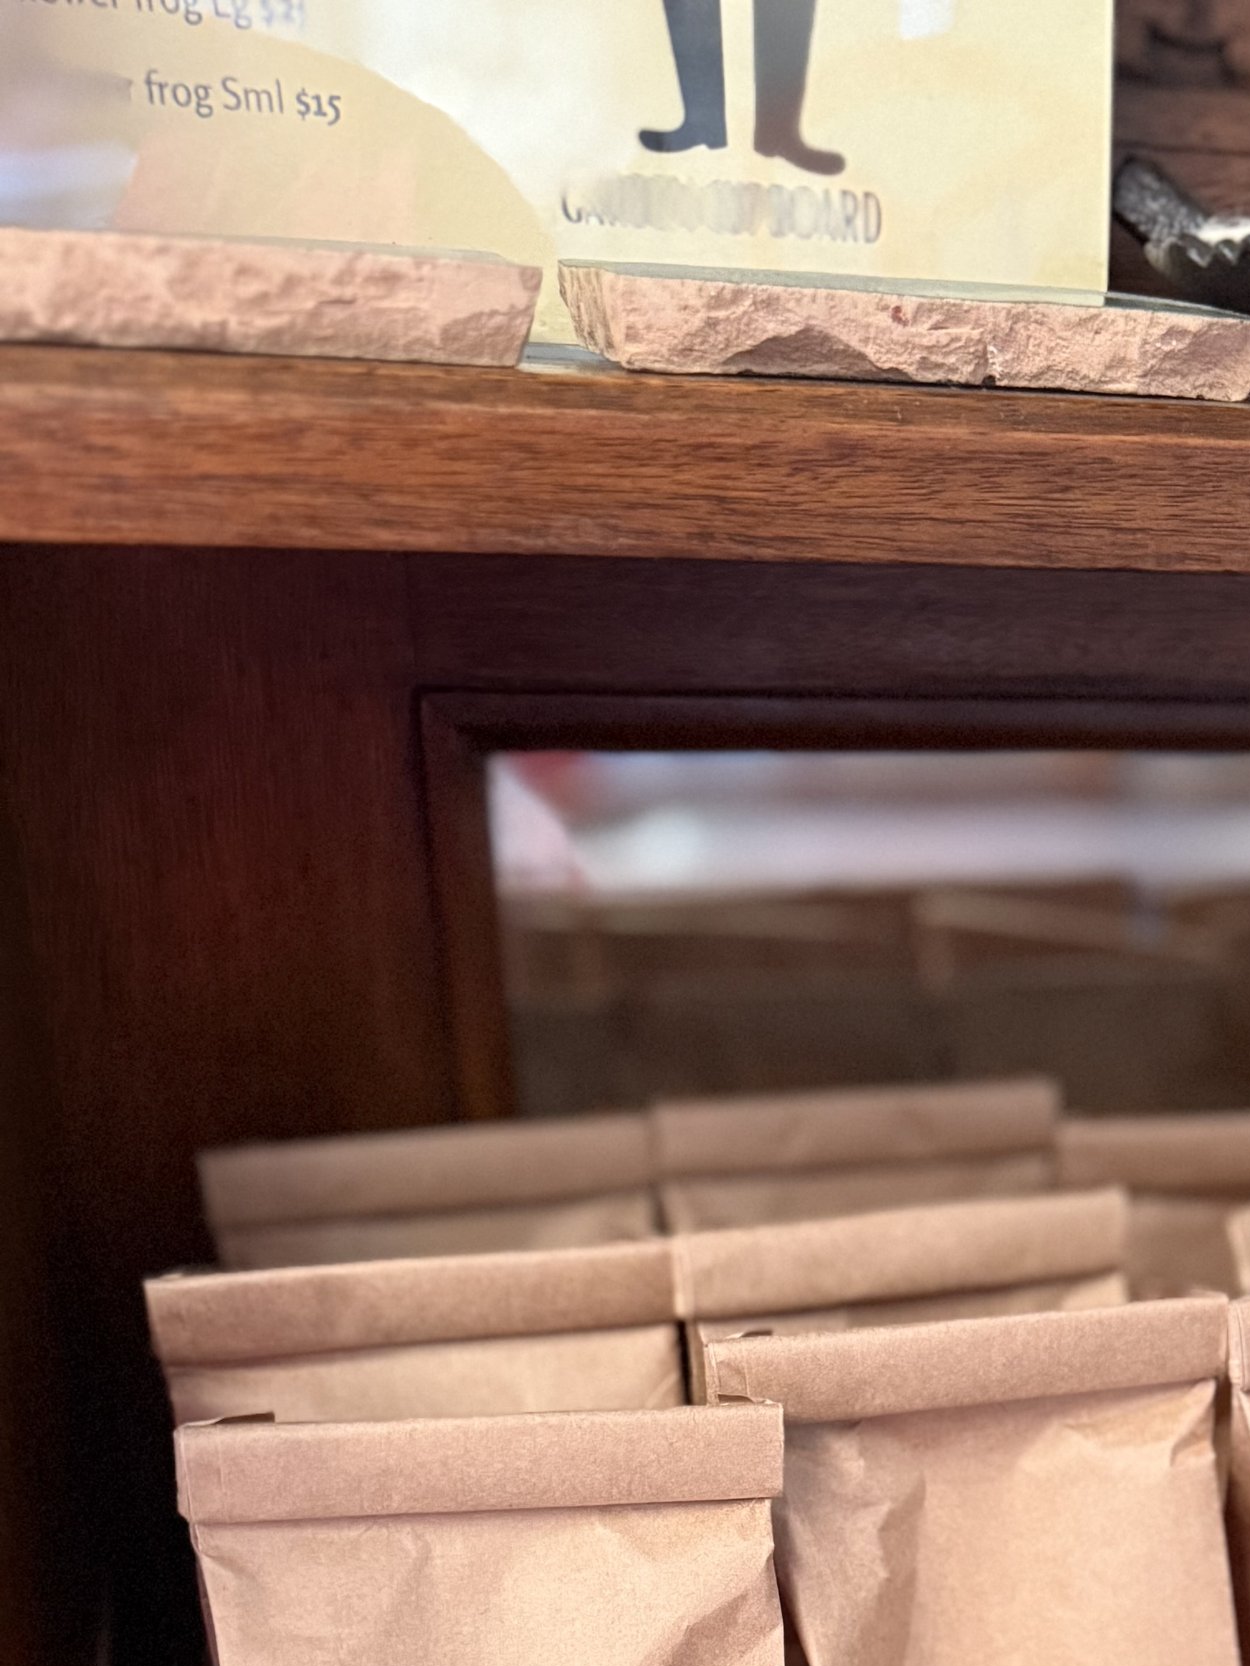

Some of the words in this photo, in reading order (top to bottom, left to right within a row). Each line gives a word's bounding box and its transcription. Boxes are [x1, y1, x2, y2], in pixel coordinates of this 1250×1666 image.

[145, 69, 213, 119] frog
[221, 76, 285, 114] Sml
[296, 88, 342, 126] $15
